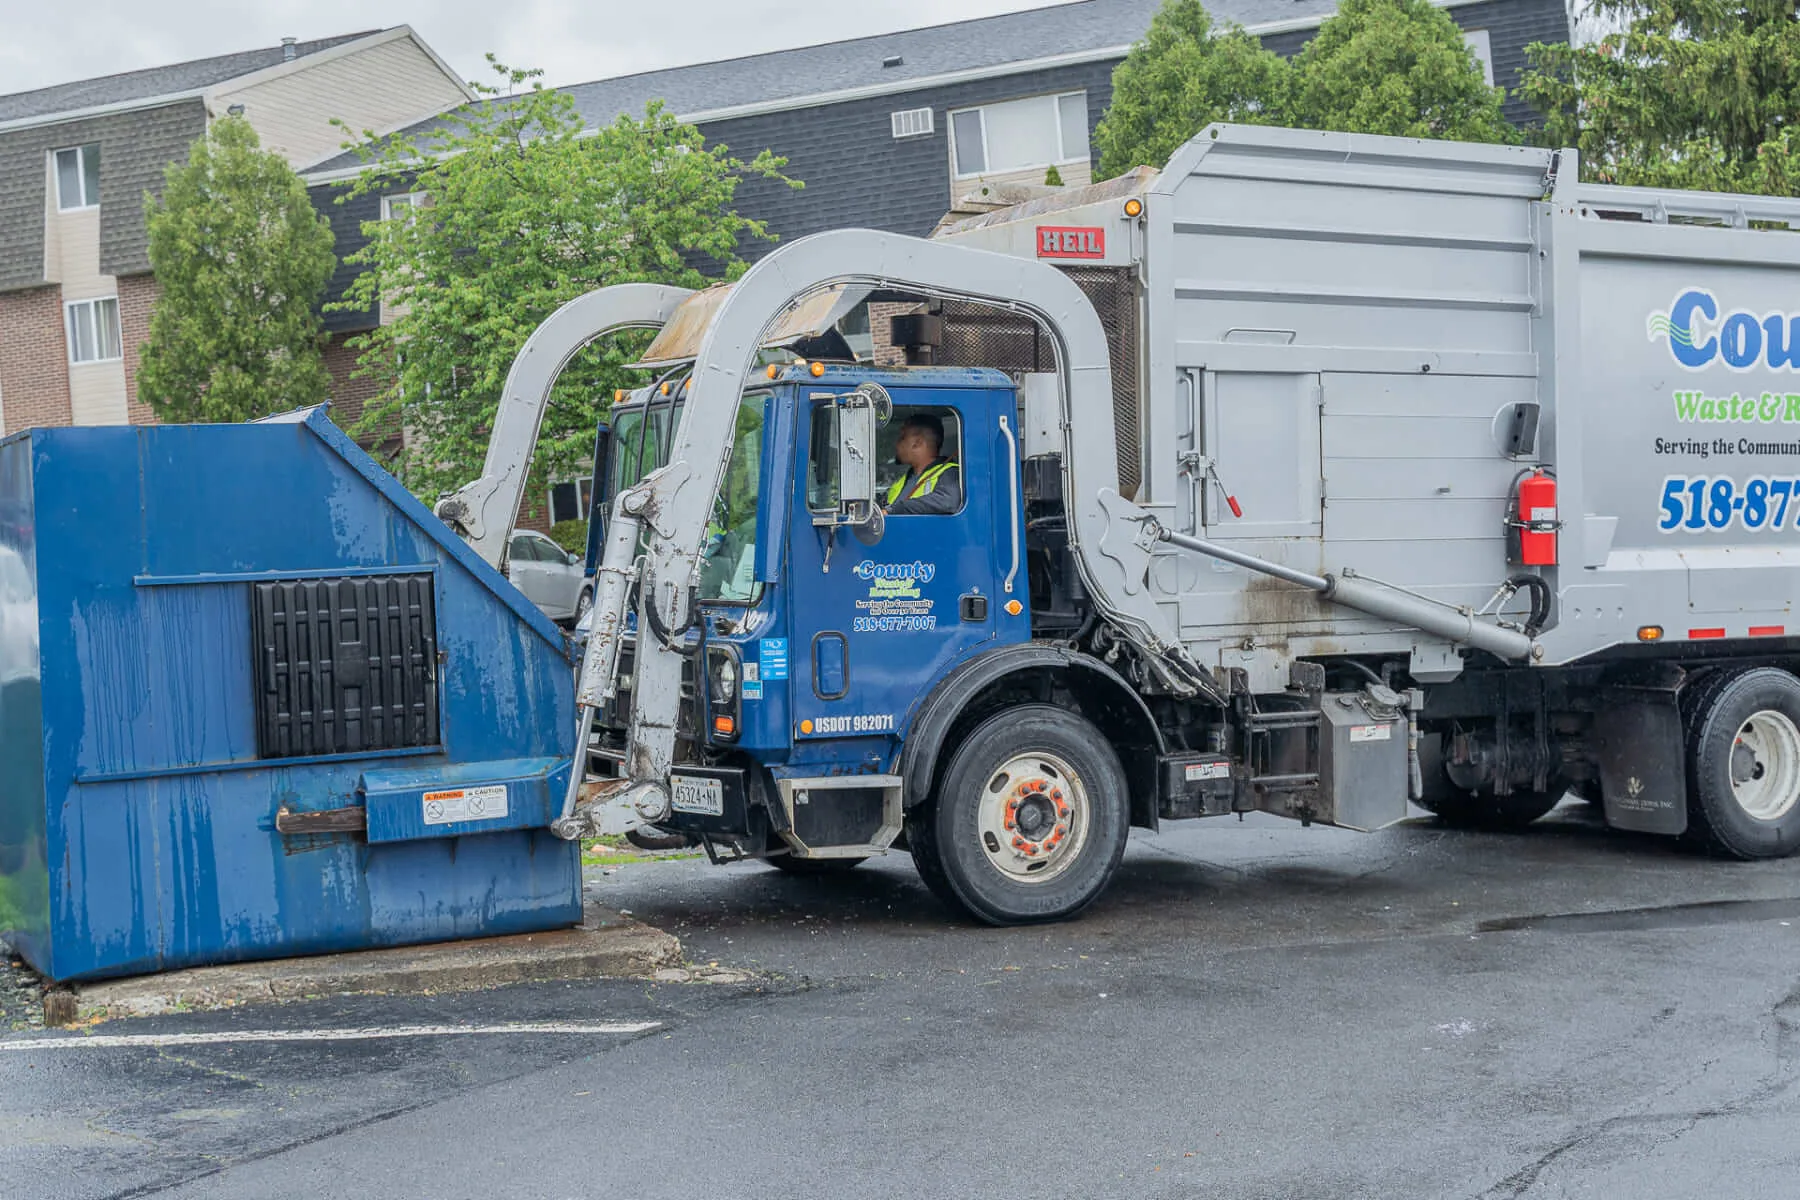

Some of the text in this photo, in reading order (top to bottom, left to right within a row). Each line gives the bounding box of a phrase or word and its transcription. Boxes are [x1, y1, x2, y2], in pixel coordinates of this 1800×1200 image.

[1043, 231, 1102, 252] HEIL
[1668, 289, 1800, 370] Cou
[1655, 438, 1709, 458] Serving
[1712, 438, 1734, 454] the
[857, 560, 936, 583] County
[854, 616, 937, 632] 518-877-7007
[815, 714, 894, 733] USDOT 982071
[474, 786, 504, 796] CAUTION
